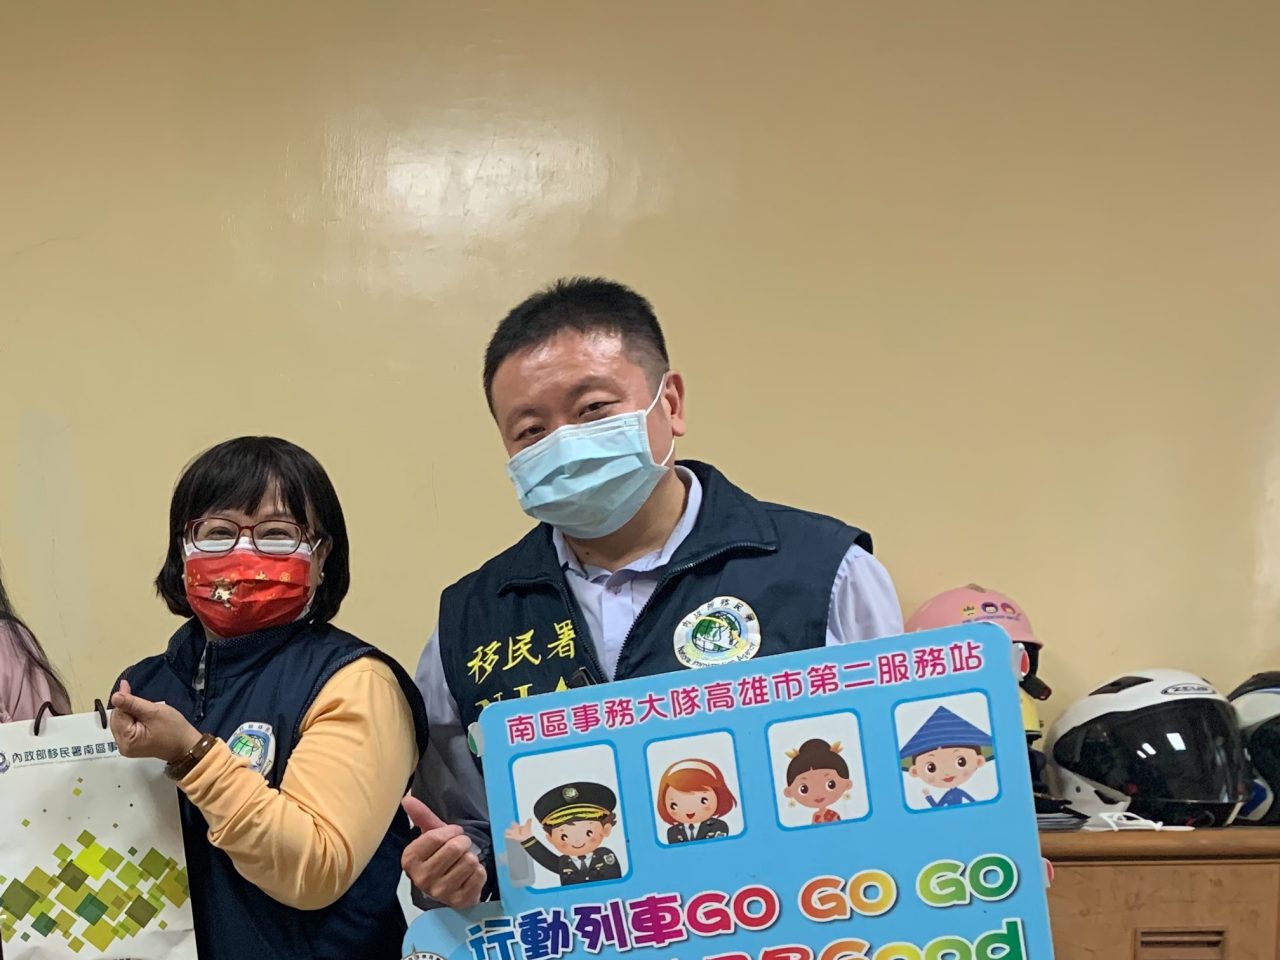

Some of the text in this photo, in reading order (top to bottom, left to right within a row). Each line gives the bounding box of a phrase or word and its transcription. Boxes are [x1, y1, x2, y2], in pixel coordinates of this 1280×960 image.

[467, 620, 577, 684] 移民署
[507, 641, 984, 745] 南區事務大隊高雄市第二服務站
[801, 870, 896, 920] GO
[918, 855, 1017, 908] GO
